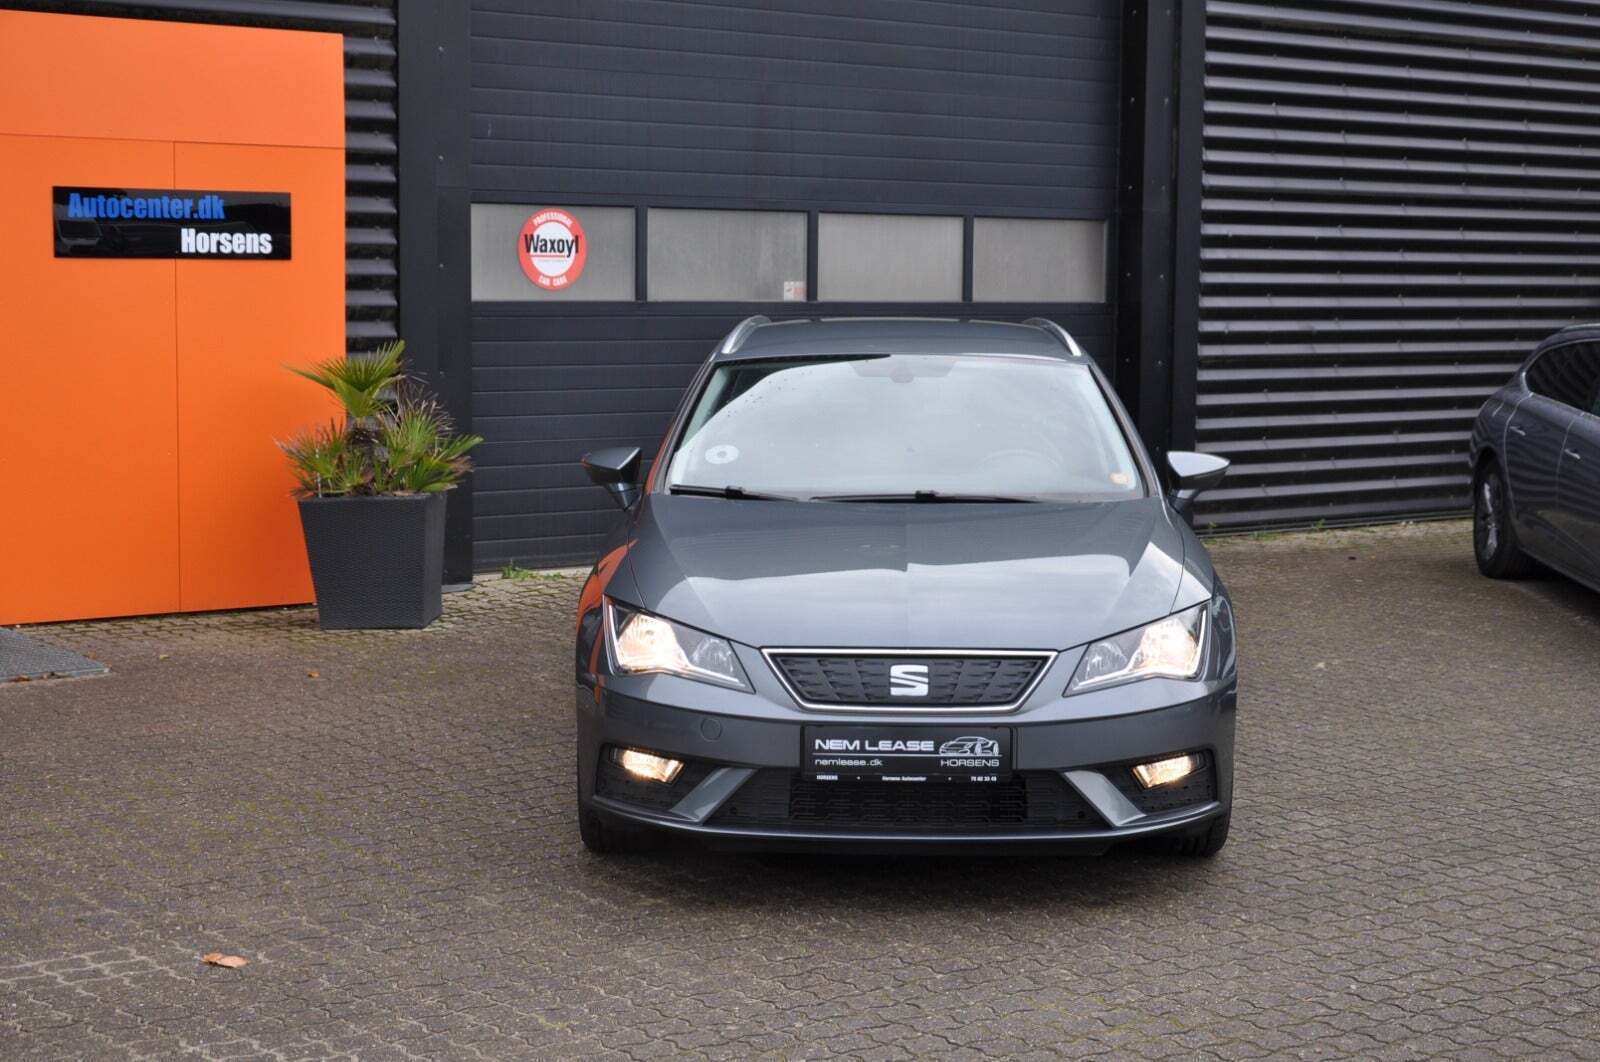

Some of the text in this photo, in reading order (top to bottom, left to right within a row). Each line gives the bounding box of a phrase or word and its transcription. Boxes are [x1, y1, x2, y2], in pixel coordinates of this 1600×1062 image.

[67, 192, 226, 220] Autocenter.dk
[180, 228, 273, 254] Horsens
[524, 234, 580, 258] Waxoyl
[814, 738, 935, 752] NEM LEASE
[814, 758, 884, 767] nemlease.dk
[940, 758, 1000, 768] HORSENS
